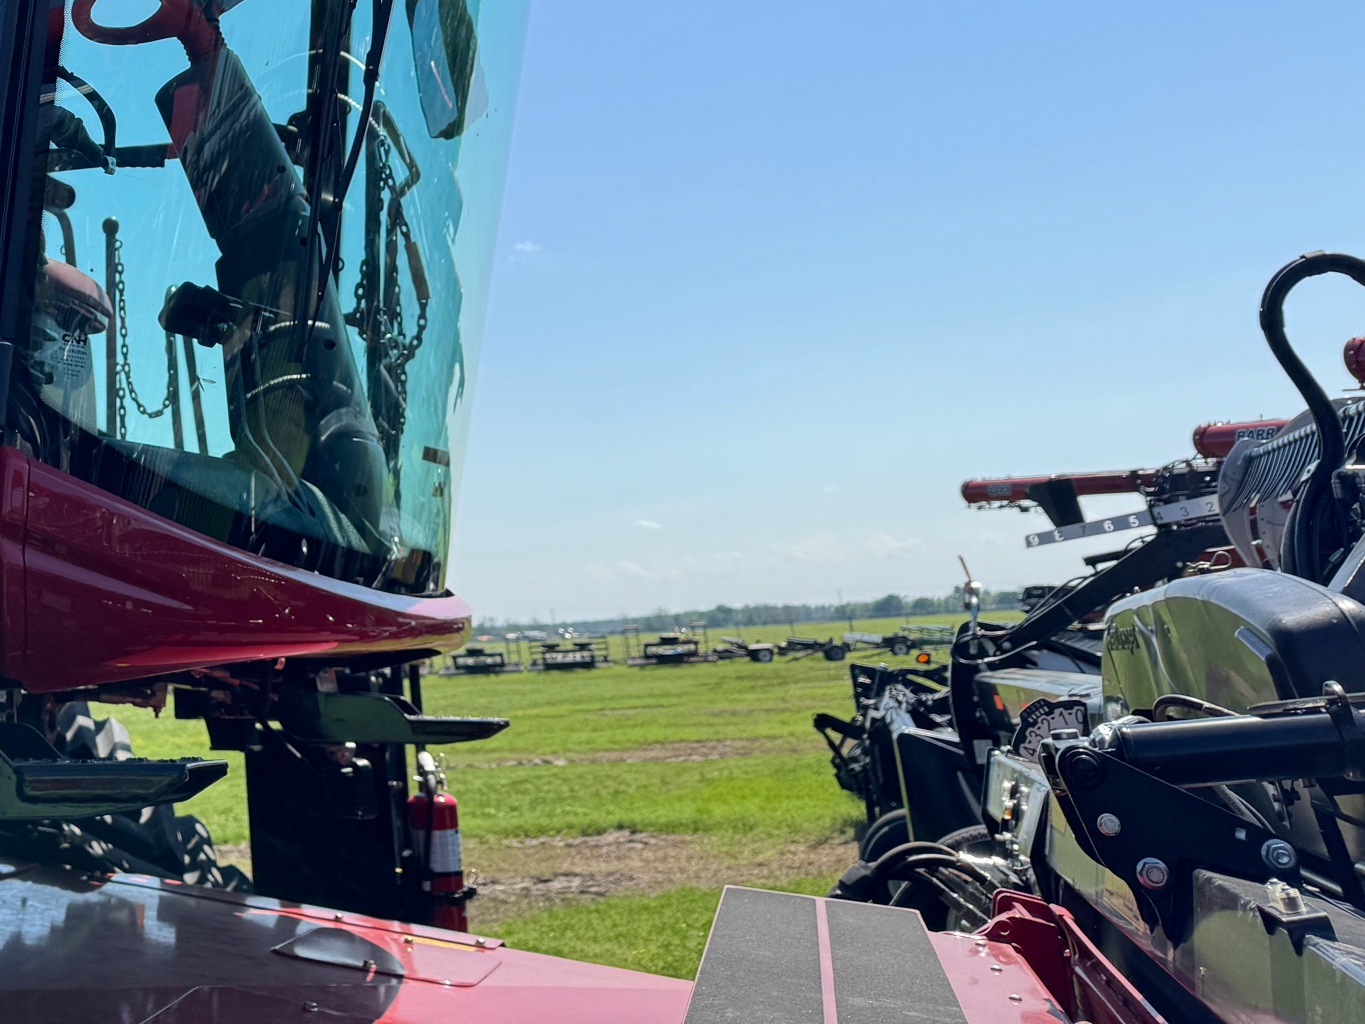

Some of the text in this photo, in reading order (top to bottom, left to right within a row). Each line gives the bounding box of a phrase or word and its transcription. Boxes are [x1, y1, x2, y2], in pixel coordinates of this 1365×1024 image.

[62, 333, 88, 346] CNH
[1102, 520, 1115, 533] 6
[1127, 515, 1140, 528] 5
[1180, 506, 1190, 517] 3
[1205, 501, 1216, 513] 2
[1022, 746, 1038, 756] 4
[1059, 710, 1069, 726] 1
[1075, 708, 1085, 725] 0
